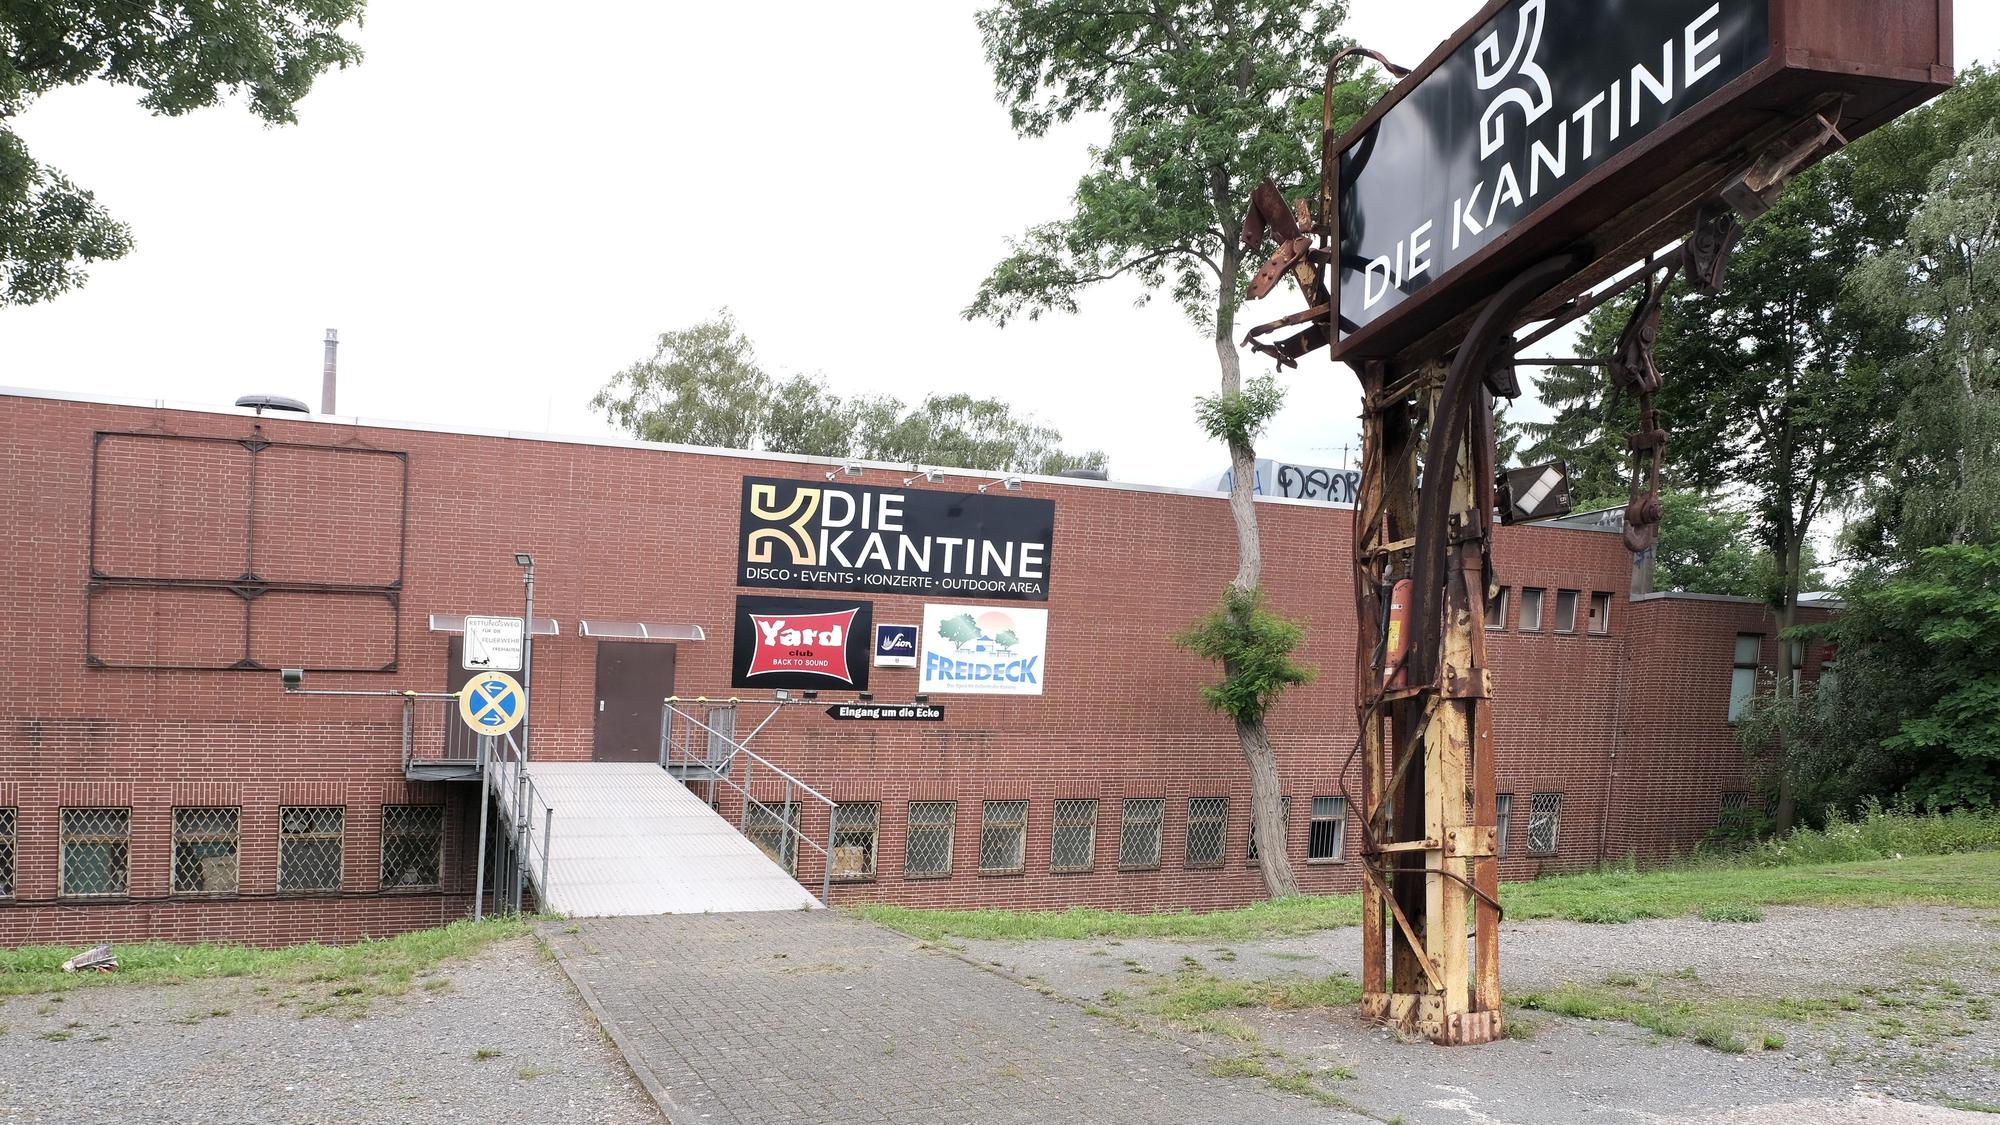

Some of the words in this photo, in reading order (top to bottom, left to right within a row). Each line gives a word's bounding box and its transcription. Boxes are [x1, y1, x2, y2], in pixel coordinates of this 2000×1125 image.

[1363, 219, 1433, 311] DIE
[1452, 2, 1721, 251] KANTINE
[820, 489, 905, 532] DIE
[818, 529, 1045, 579] KANTINE
[746, 567, 790, 581] DISCO
[801, 570, 854, 584] EVENTS
[864, 573, 933, 588] KONZERTE
[942, 578, 1006, 592] OUTDOOR
[1007, 581, 1042, 594] AREA
[757, 620, 843, 647] Yard
[880, 632, 913, 651] Sion
[772, 658, 792, 666] BACK
[805, 659, 829, 667] SOUND
[788, 649, 814, 657] club
[925, 651, 1039, 684] FREIDECK
[839, 706, 880, 719] Eingang
[881, 709, 897, 717] um
[898, 707, 915, 718] die
[916, 707, 940, 718] Ecke
